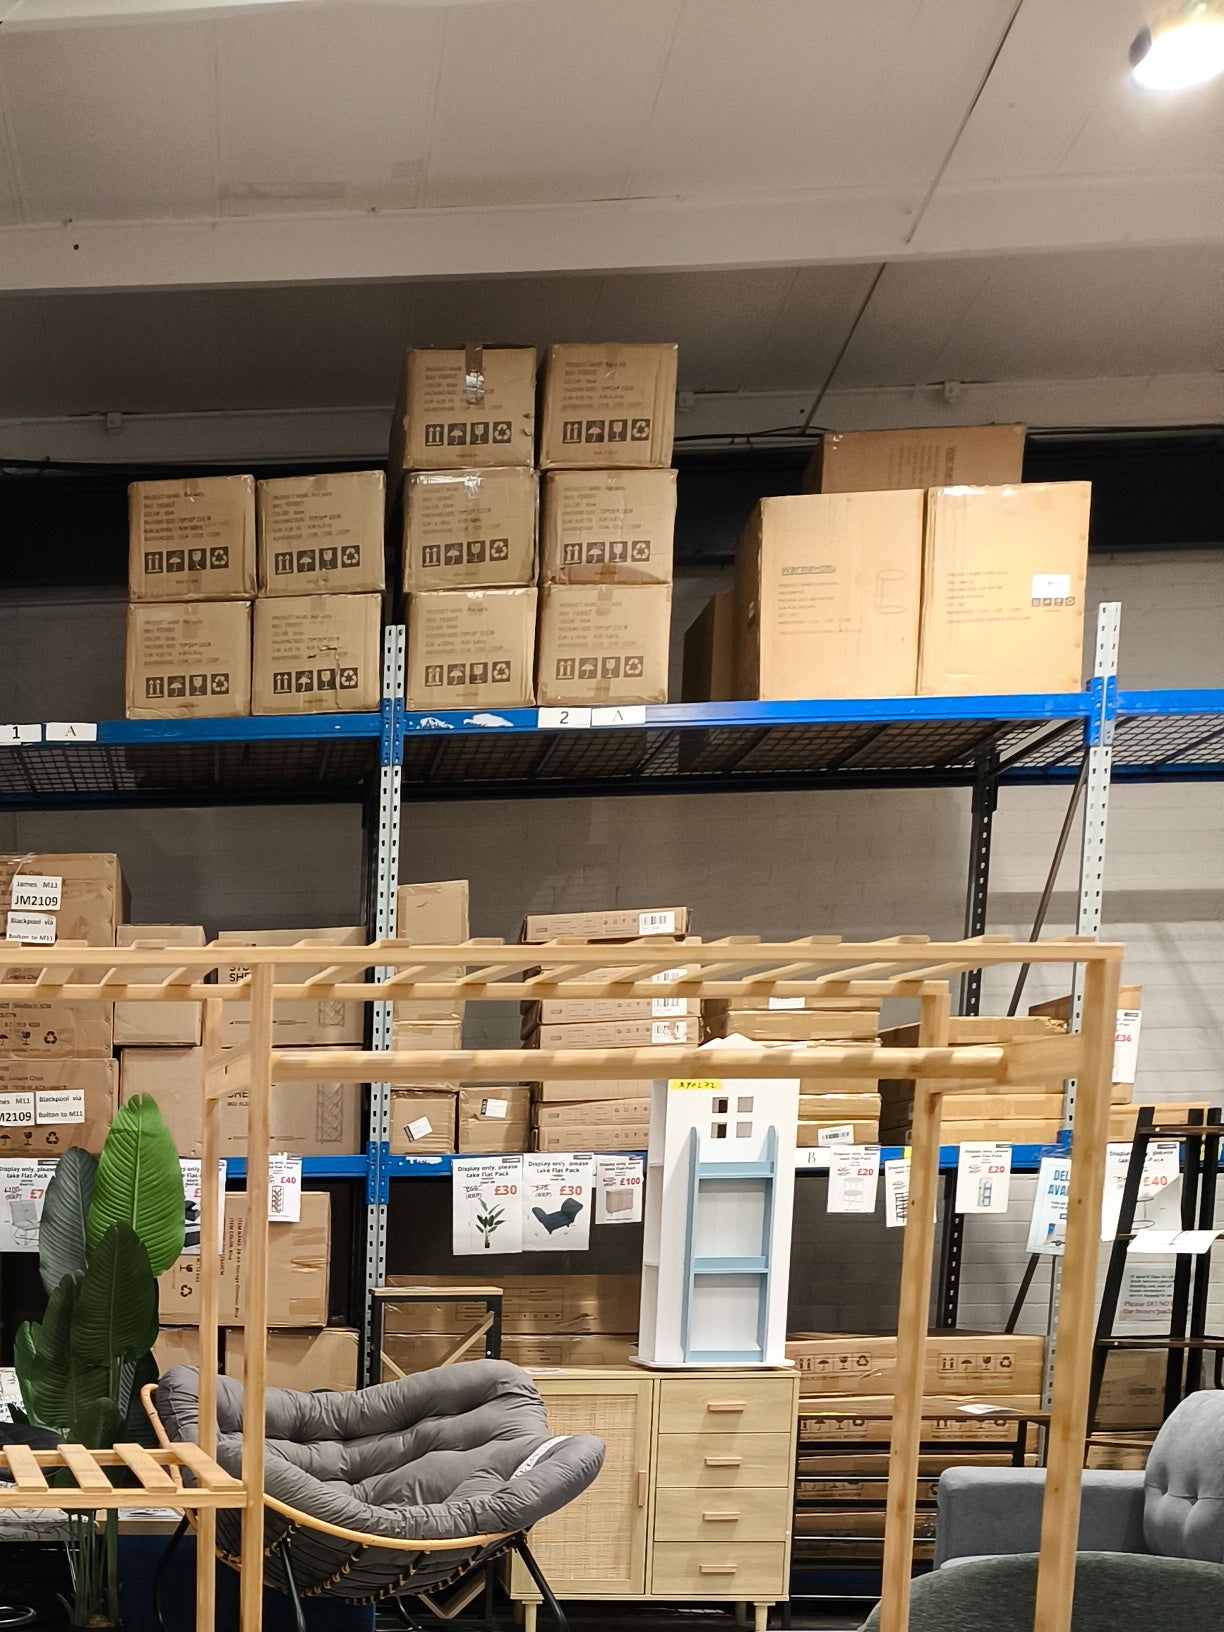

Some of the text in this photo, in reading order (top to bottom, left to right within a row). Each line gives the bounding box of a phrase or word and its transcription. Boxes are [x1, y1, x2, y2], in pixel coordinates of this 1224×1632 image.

[559, 711, 569, 724] 2
[12, 725, 77, 739] 1 A
[16, 880, 38, 888] James
[14, 895, 58, 907] JM2109
[10, 917, 54, 927] Blackpool via
[15, 1097, 31, 1105] M11
[38, 1095, 70, 1104] Blackpool
[38, 1111, 60, 1119] Bolton
[807, 1151, 816, 1163] B
[857, 1168, 874, 1176] £20
[988, 1165, 1005, 1174] £20
[280, 1176, 297, 1184] £40
[619, 1177, 641, 1186] £100
[1143, 1176, 1168, 1187] £40
[494, 1184, 518, 1196] £30
[559, 1185, 583, 1196] £30
